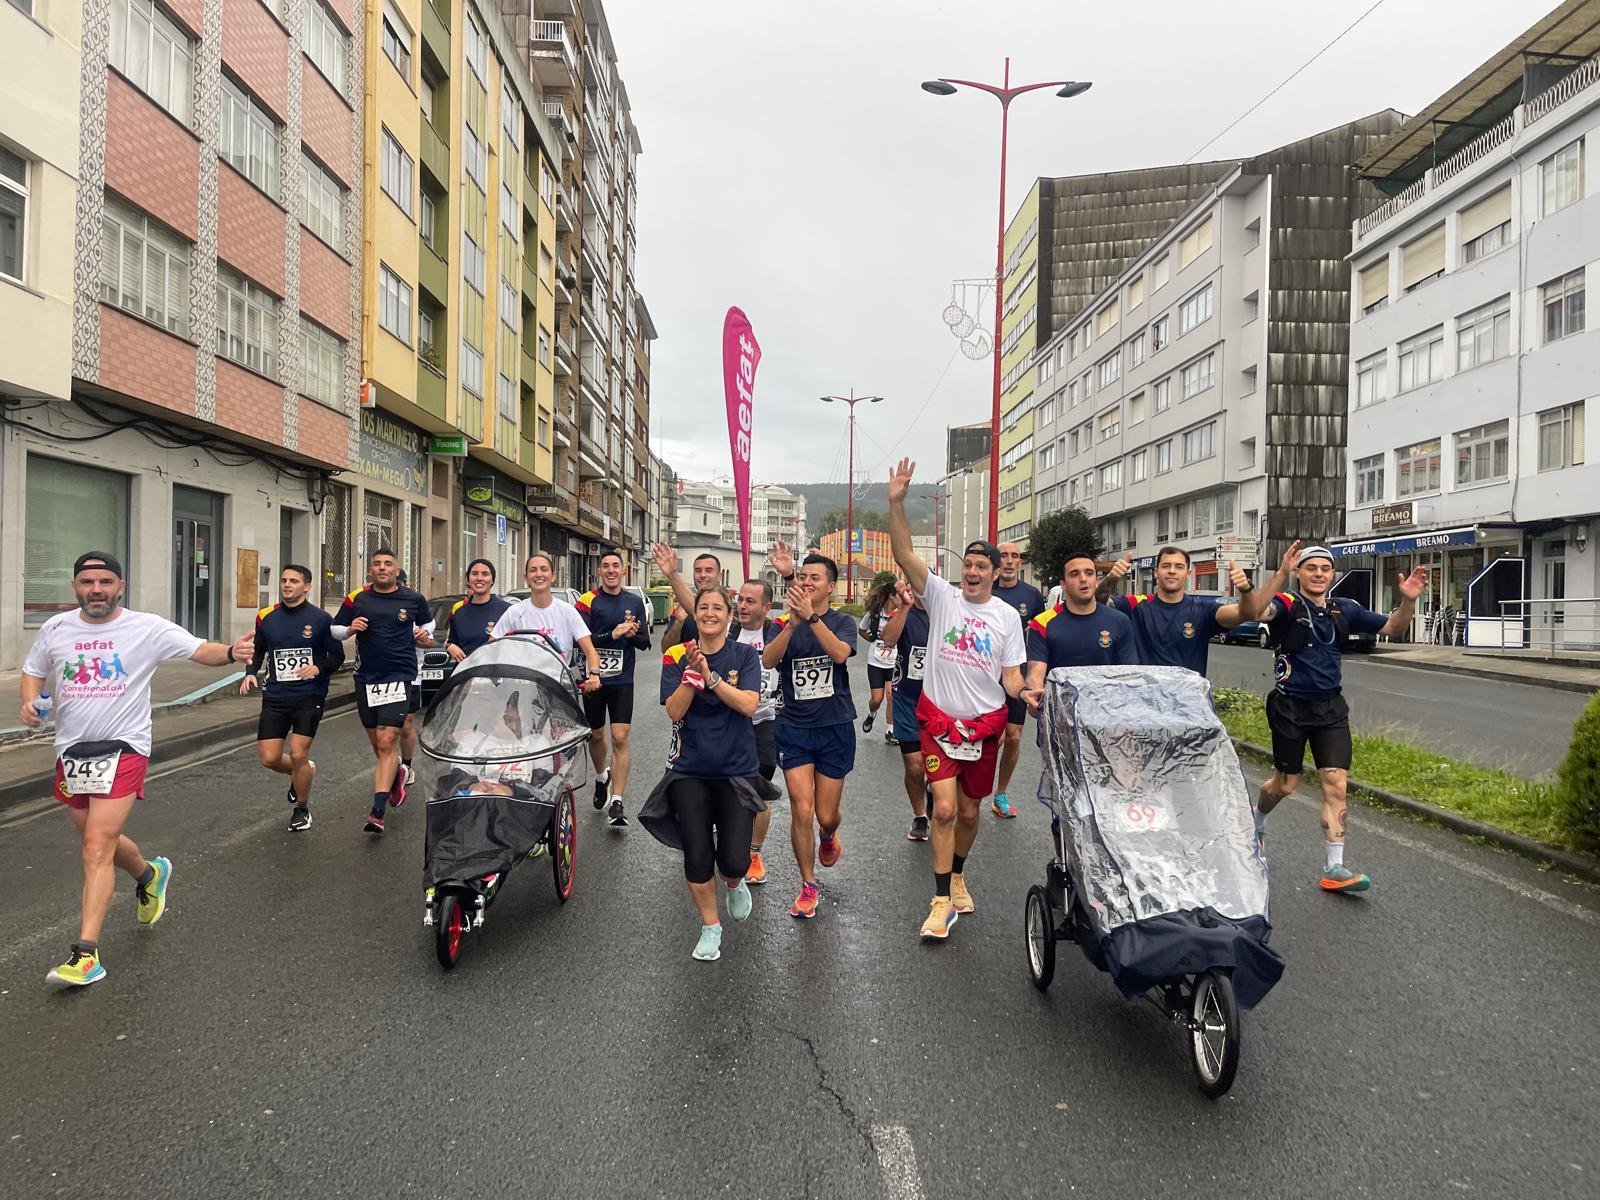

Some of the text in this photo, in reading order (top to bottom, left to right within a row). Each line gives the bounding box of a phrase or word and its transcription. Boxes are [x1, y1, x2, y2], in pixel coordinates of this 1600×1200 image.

[736, 333, 754, 462] aefat
[376, 416, 412, 452] MARTINEZ
[1373, 511, 1410, 523] BREAMO
[1342, 535, 1450, 555] CAFE BAR BREAMO
[74, 640, 114, 651] aefat
[277, 657, 310, 671] 598
[599, 657, 619, 670] 32
[426, 670, 442, 679] FYS
[795, 667, 832, 687] 597
[371, 681, 401, 695] 477
[64, 759, 112, 778] 249
[1127, 804, 1156, 825] 69
